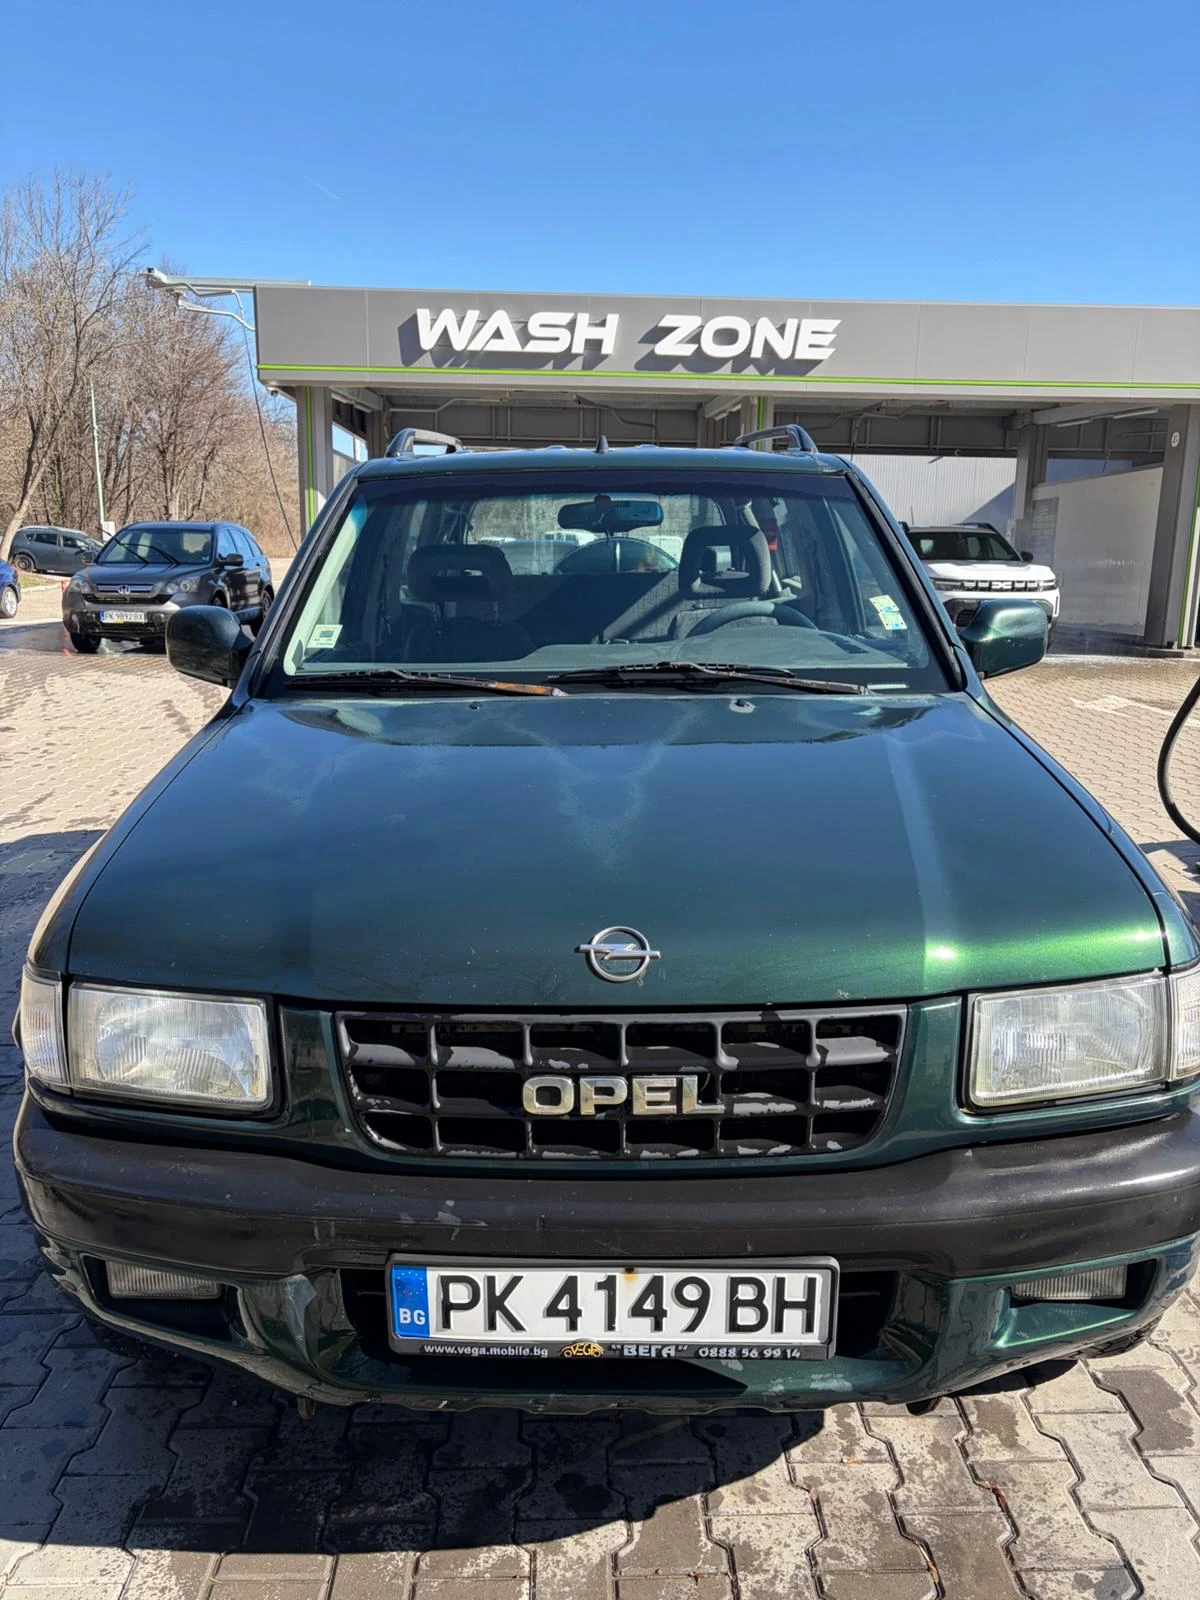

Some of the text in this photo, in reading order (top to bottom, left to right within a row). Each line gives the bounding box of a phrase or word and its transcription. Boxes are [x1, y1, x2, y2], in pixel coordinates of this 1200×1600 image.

[416, 308, 841, 360] WASH ZONE
[522, 1075, 725, 1116] OPEL
[399, 1308, 426, 1325] BG
[436, 1274, 818, 1334] PK 4149 BH
[423, 1343, 549, 1358] www.vega.mobile.bg
[698, 1347, 801, 1358] 0888 56 99 14
